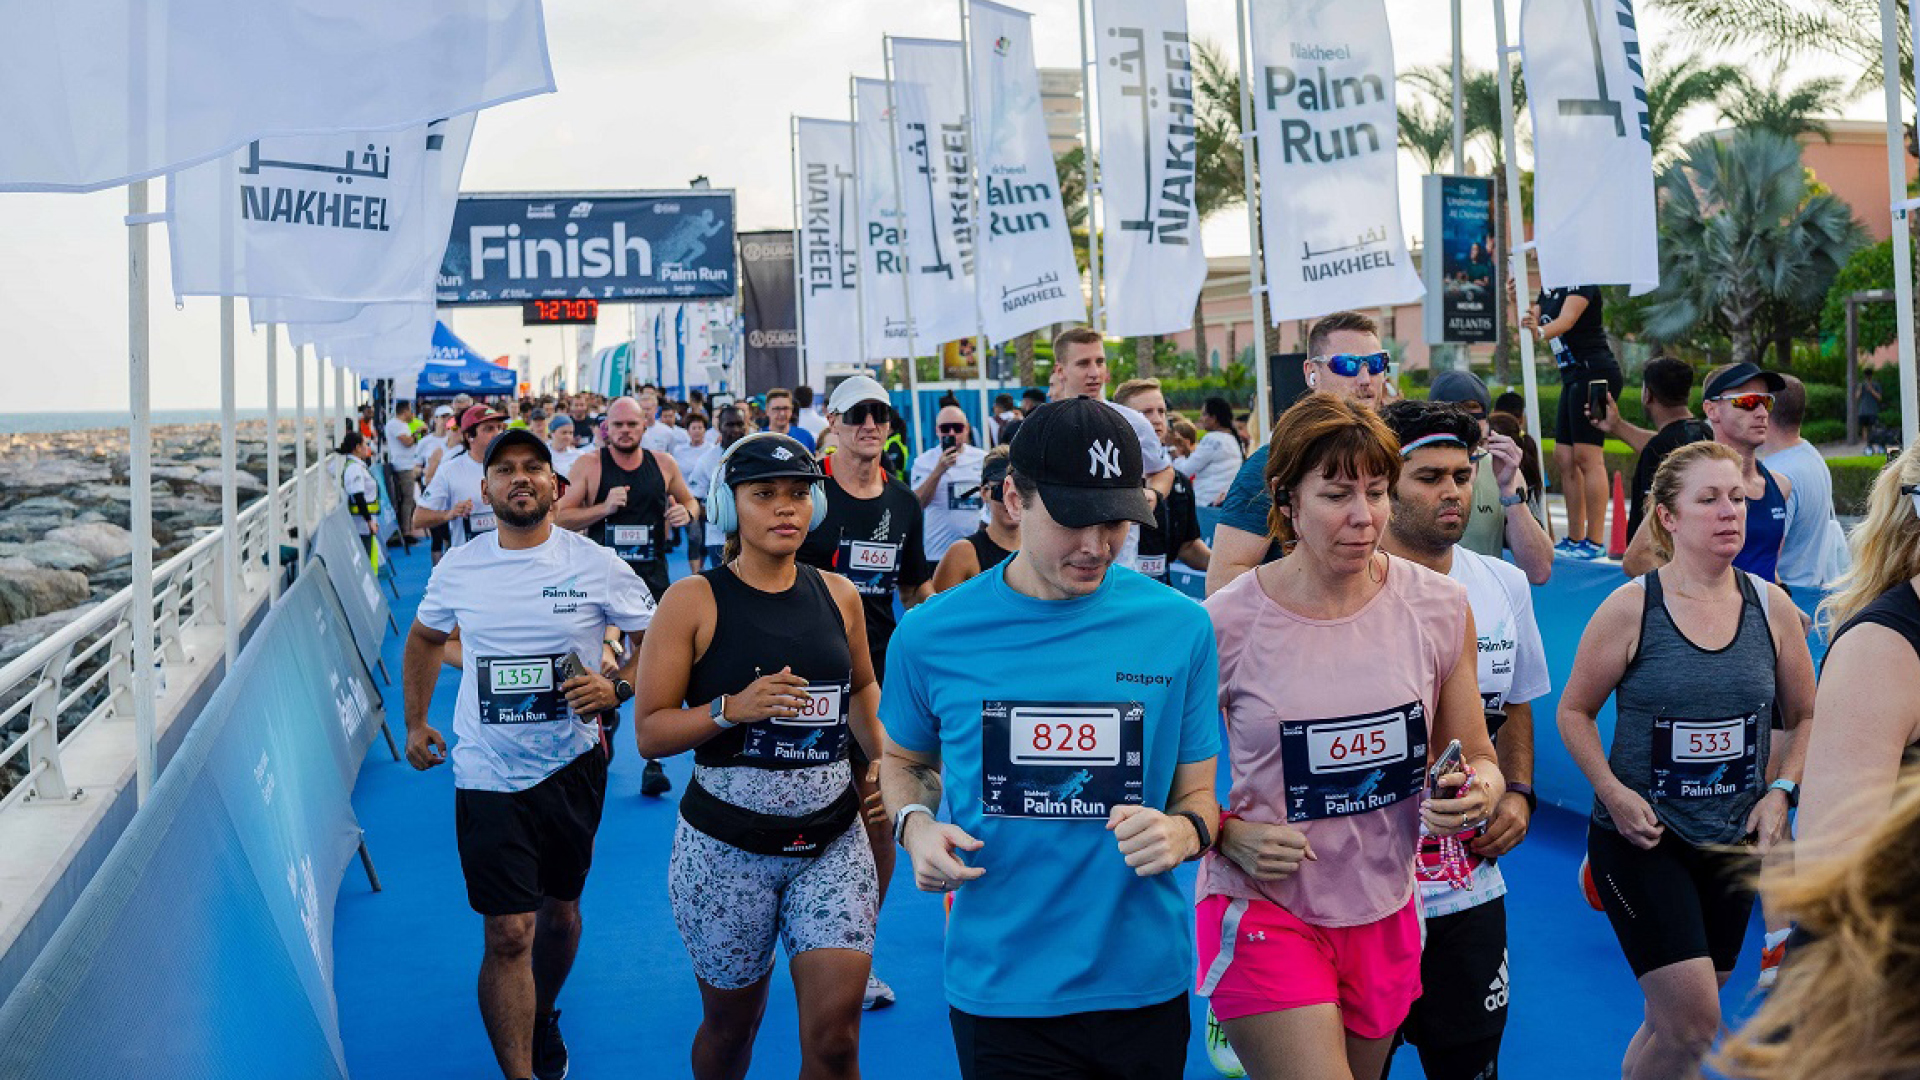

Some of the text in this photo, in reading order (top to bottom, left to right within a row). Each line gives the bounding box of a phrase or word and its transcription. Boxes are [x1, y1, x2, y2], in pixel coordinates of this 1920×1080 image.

[1290, 42, 1351, 60] Nakheel
[1265, 66, 1385, 111] Palm
[1157, 31, 1196, 246] NAKHEEL
[1280, 118, 1380, 164] Run
[240, 185, 390, 232] NAKHEEL
[806, 163, 833, 297] NAKHEEL
[469, 221, 653, 280] Finish
[875, 250, 909, 274] Ru
[1302, 249, 1395, 282] NAKHEEL
[661, 266, 728, 282] Palm Run
[534, 300, 598, 320] 7:27:07
[1002, 286, 1066, 314] NAKHEEL
[1449, 317, 1492, 330] ATLANTIS
[766, 330, 797, 347] DUBA
[1088, 438, 1122, 479] NY
[860, 549, 888, 564] 466
[543, 589, 588, 598] Palm Run
[1477, 641, 1501, 653] Palm
[497, 667, 544, 686] 1357
[1116, 671, 1173, 687] postpay
[499, 711, 547, 723] Palm Run
[1032, 723, 1097, 752] 828
[1330, 729, 1387, 760] 645
[1689, 731, 1731, 753] 533
[775, 746, 830, 760] Palm Run
[1681, 782, 1736, 797] Palm Run
[1024, 797, 1106, 815] Palm Run
[1325, 791, 1397, 815] Palm Run
